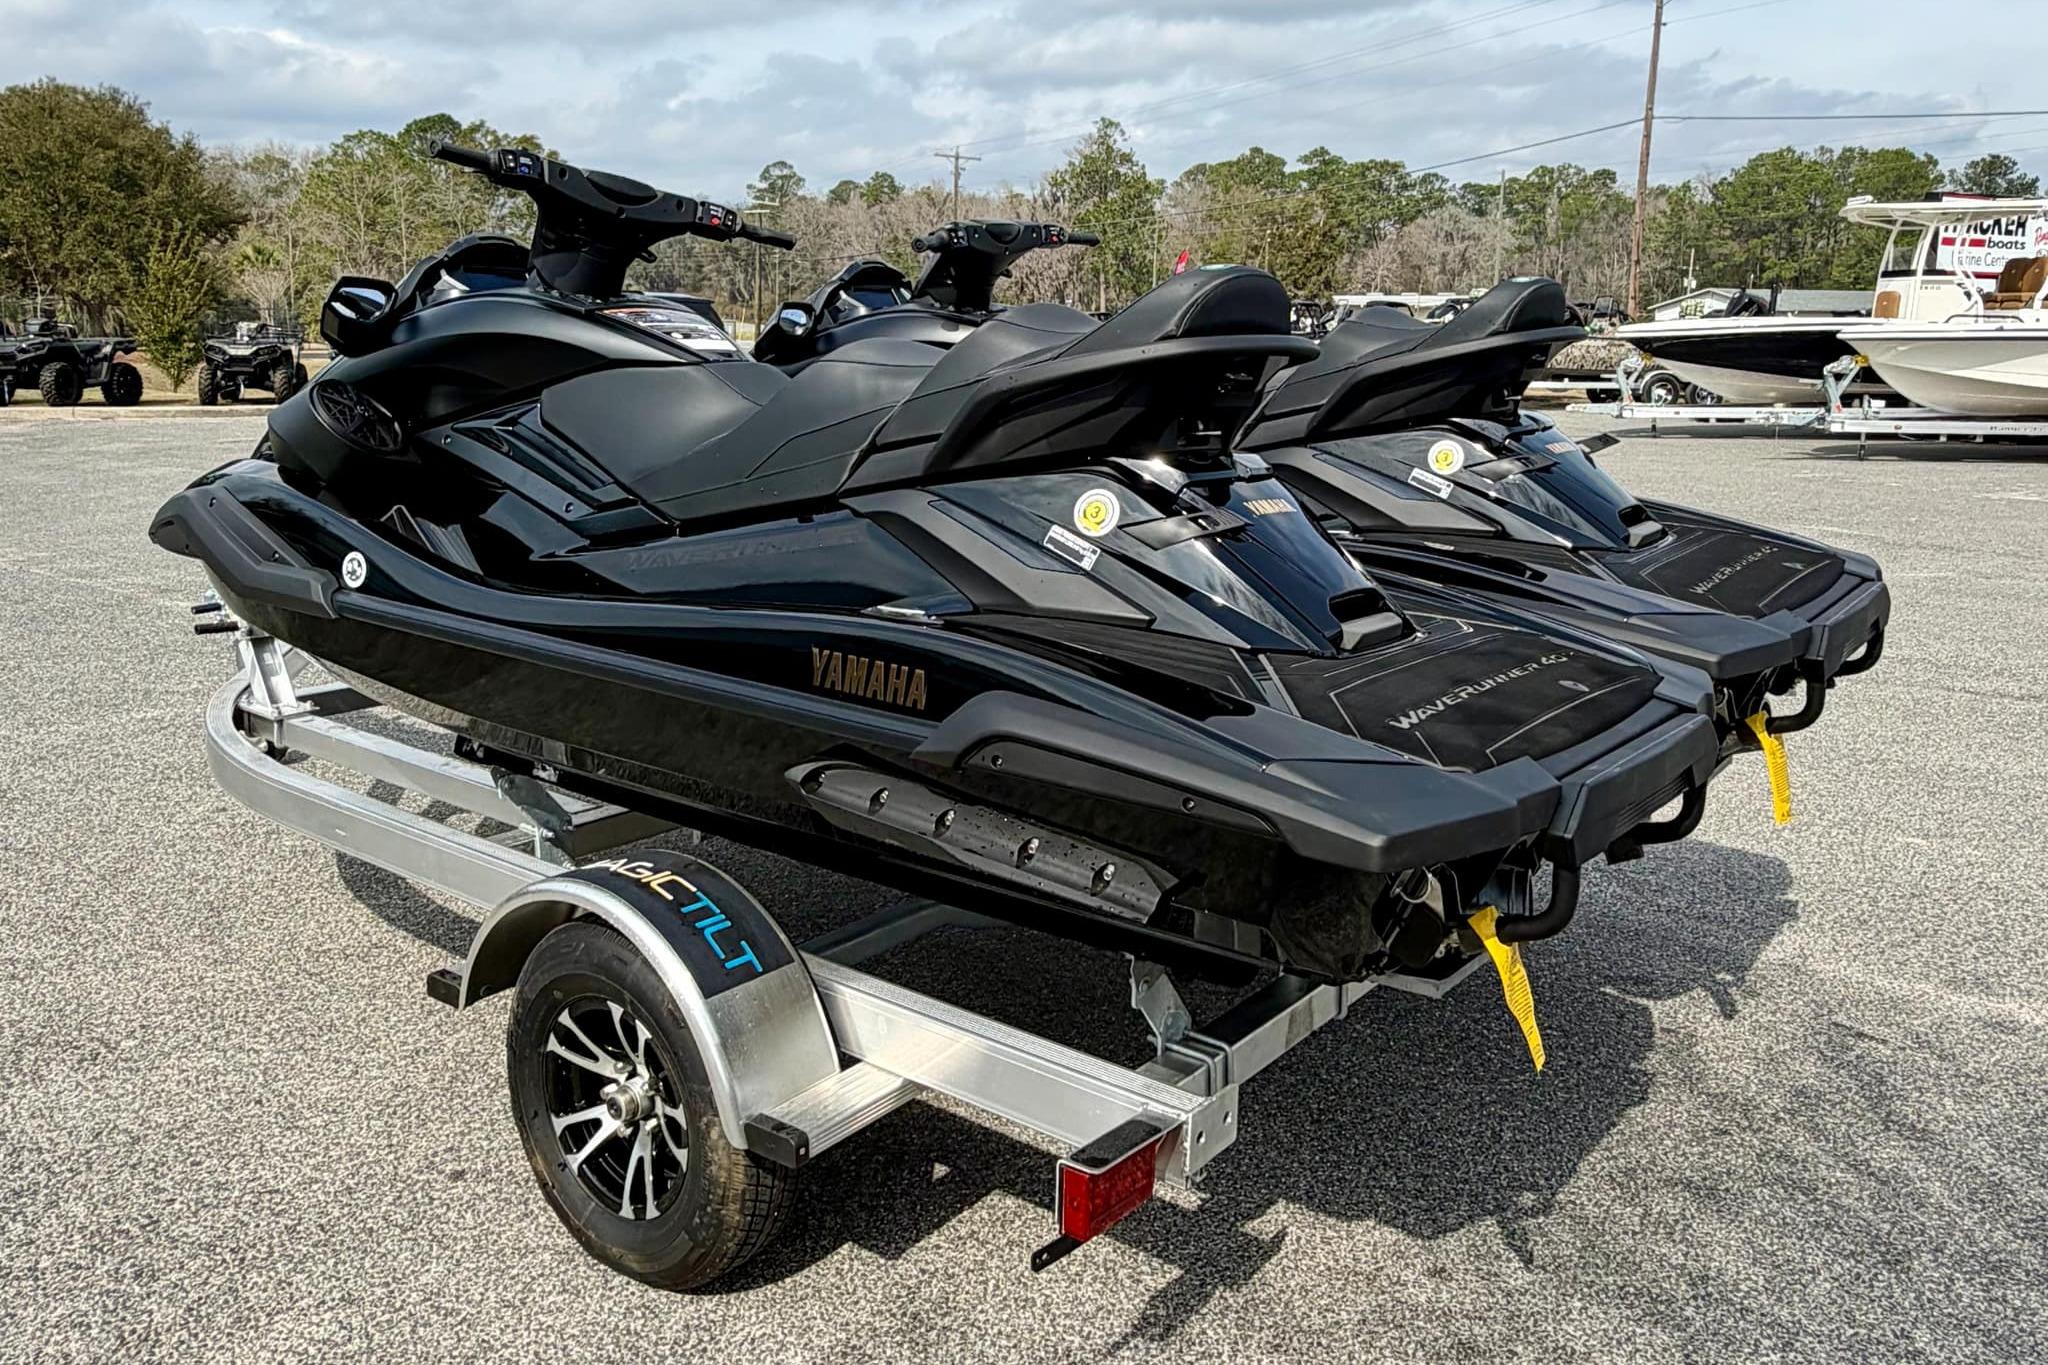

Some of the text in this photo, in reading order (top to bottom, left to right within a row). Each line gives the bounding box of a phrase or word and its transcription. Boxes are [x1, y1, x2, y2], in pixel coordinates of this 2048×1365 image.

[1987, 236, 2026, 250] boats
[1090, 505, 1102, 519] 3
[811, 646, 926, 710] YAMAHA
